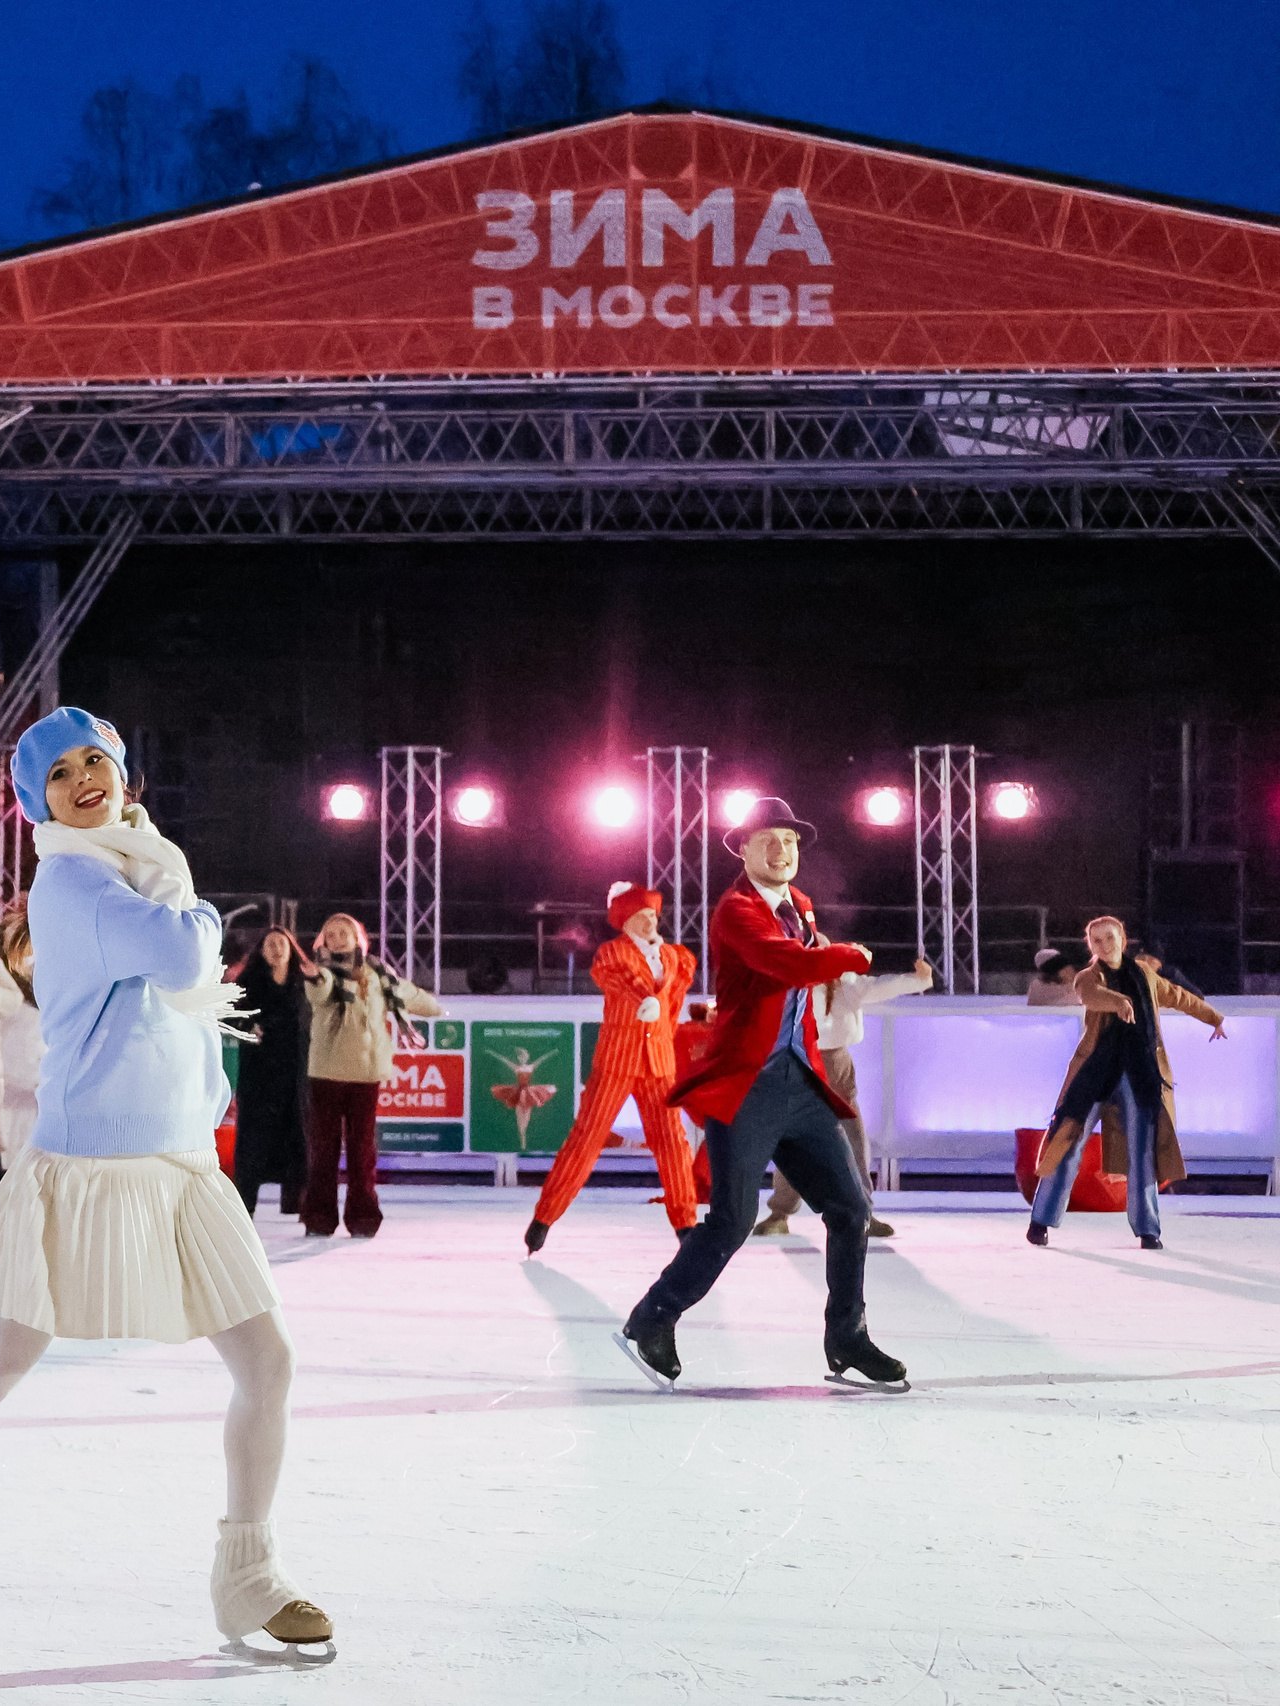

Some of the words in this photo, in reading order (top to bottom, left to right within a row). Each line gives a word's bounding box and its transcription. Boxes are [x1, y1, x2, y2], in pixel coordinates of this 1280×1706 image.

[472, 188, 833, 270] ЗИМА
[472, 286, 515, 329] В
[541, 284, 834, 329] МОСКВЕ
[380, 1065, 445, 1089] МА
[378, 1092, 446, 1107] ОСКВЕ
